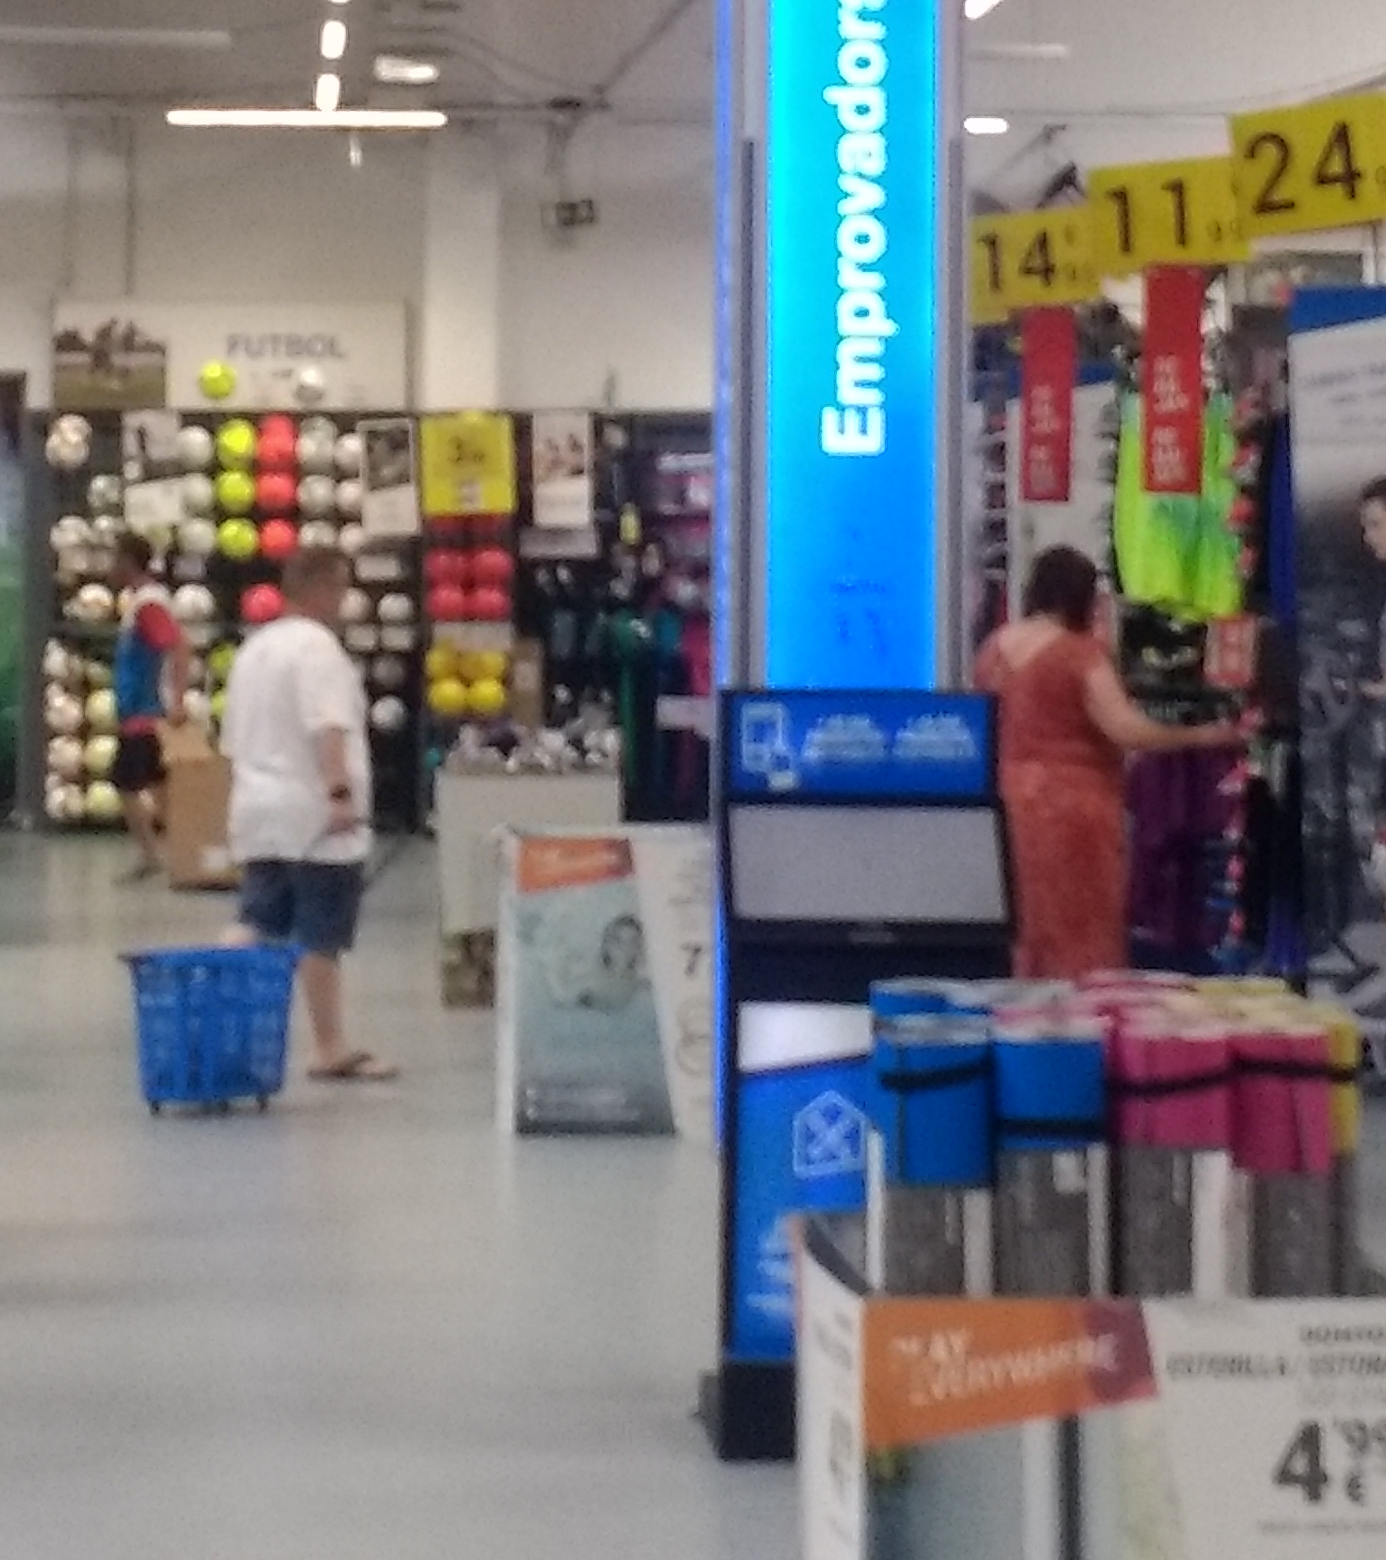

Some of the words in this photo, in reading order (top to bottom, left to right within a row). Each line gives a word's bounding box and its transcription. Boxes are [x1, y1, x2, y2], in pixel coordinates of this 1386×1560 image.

[1243, 119, 1363, 216] 24
[1106, 180, 1188, 255] 11
[975, 227, 1056, 292] 14
[1272, 1419, 1329, 1503] 4
